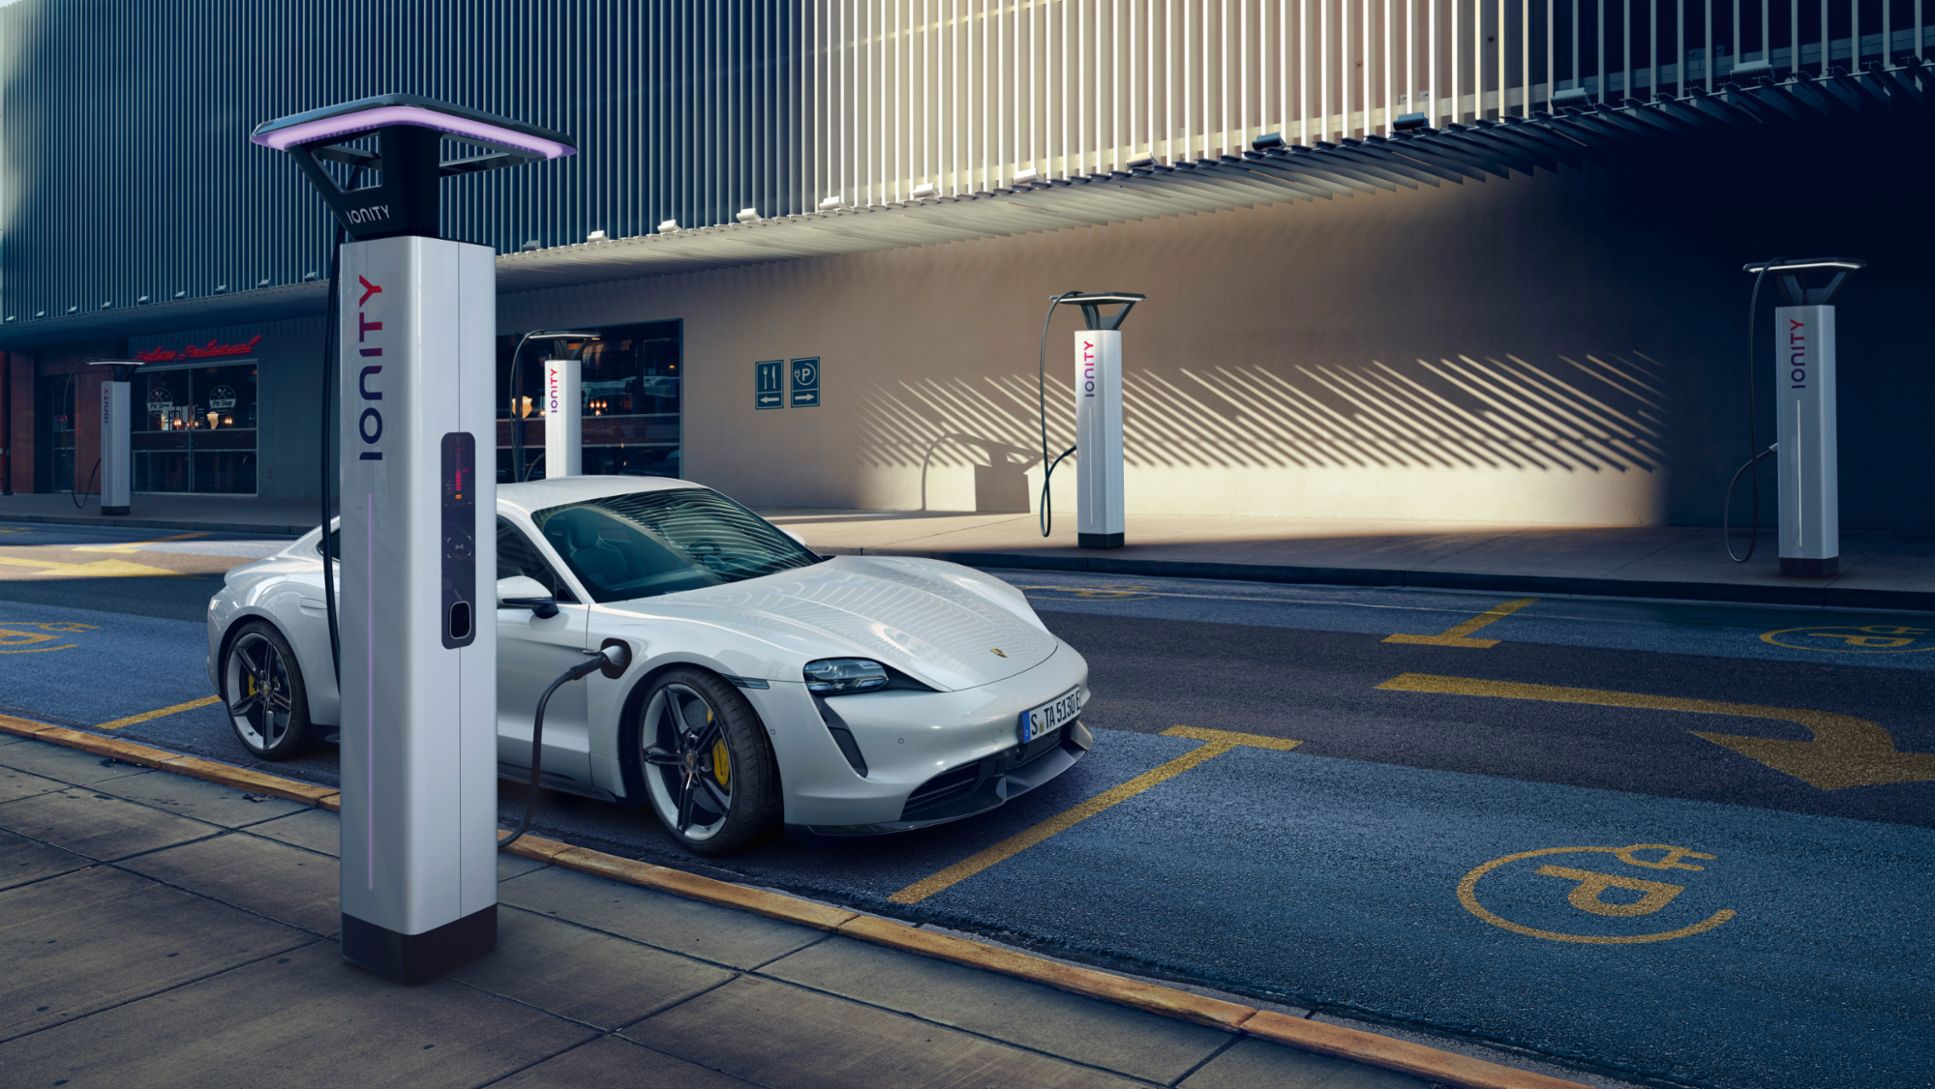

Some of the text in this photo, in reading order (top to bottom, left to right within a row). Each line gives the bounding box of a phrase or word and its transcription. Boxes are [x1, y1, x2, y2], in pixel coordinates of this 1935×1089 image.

[345, 203, 391, 225] IONITY
[358, 273, 384, 462] IONITY
[1083, 340, 1095, 398] IONITY
[1790, 318, 1806, 389] IONITY
[550, 368, 558, 413] IONITY
[1030, 713, 1038, 736] S
[1044, 705, 1056, 729] TA
